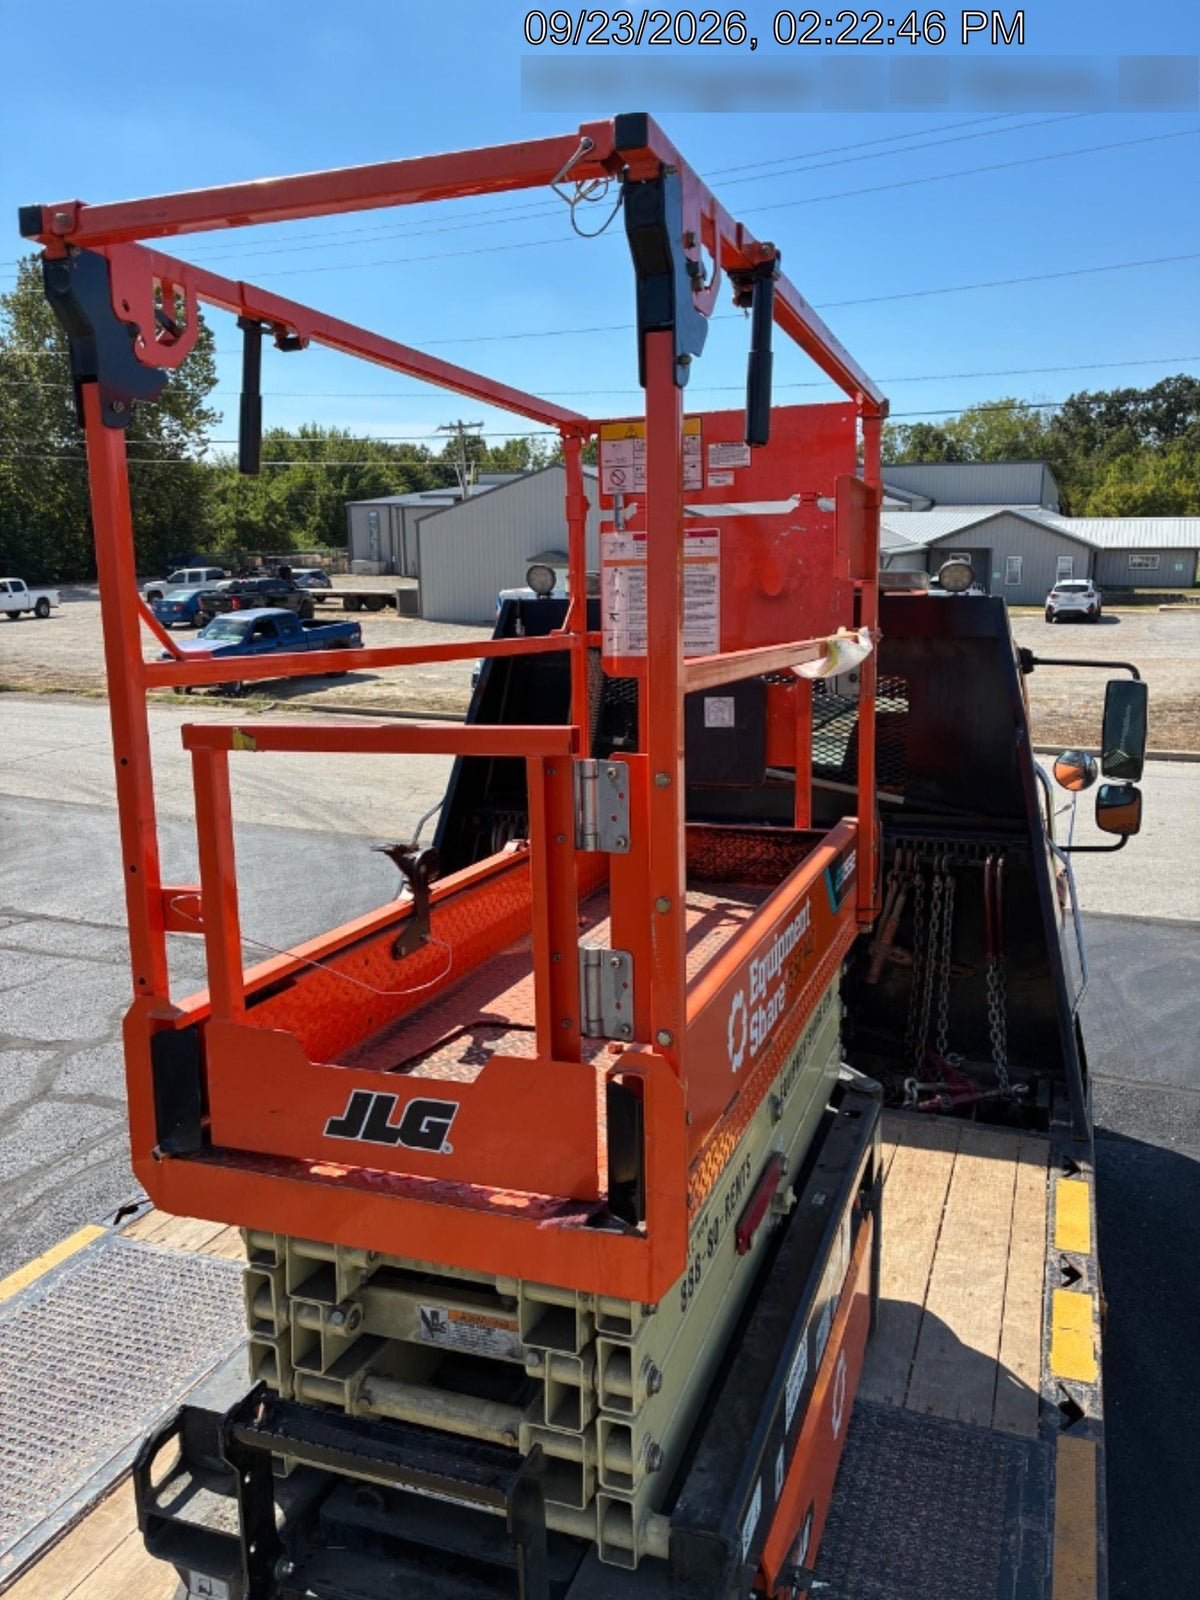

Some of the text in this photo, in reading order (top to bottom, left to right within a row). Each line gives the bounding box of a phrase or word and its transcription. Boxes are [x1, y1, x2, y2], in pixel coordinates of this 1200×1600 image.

[749, 896, 812, 1006] Equipment
[749, 981, 786, 1058] Share
[323, 1088, 459, 1153] JLG
